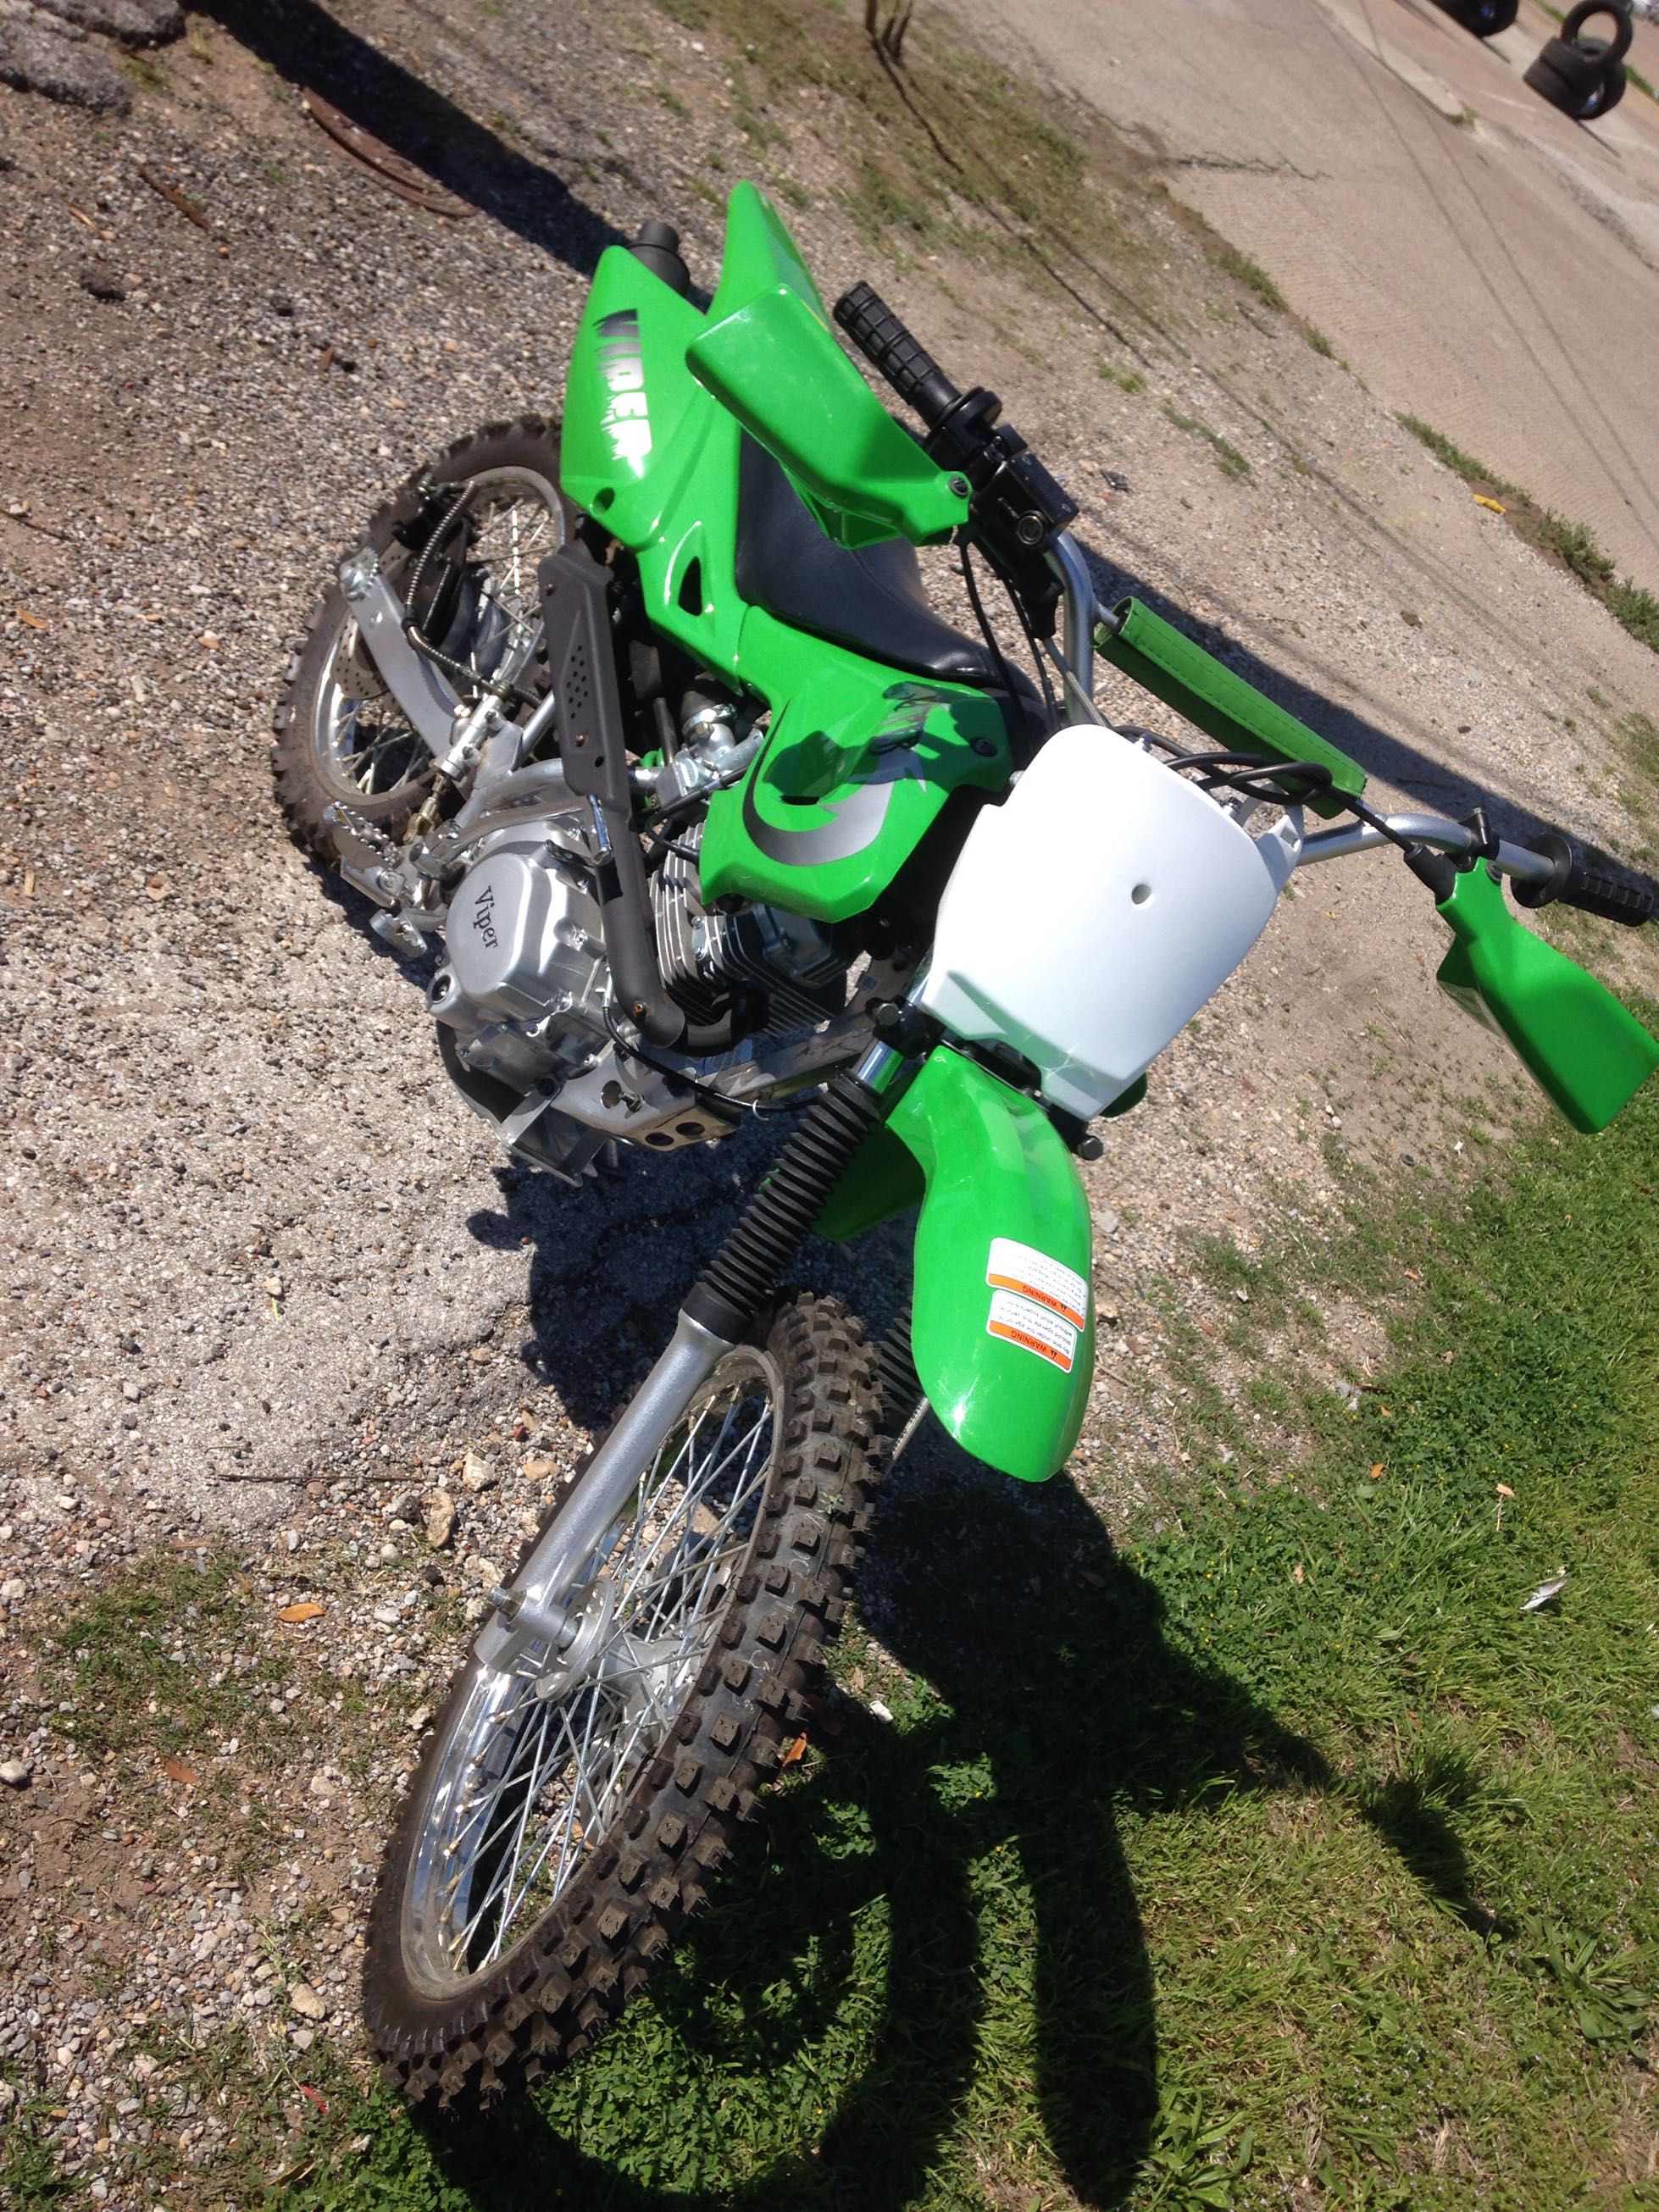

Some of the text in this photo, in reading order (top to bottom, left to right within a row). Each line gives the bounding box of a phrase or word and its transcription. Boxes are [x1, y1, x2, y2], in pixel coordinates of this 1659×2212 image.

[592, 308, 652, 466] VIPER
[473, 884, 498, 949] Viper
[1022, 1285, 1057, 1307] WARNING
[1011, 1330, 1046, 1352] WARNING
